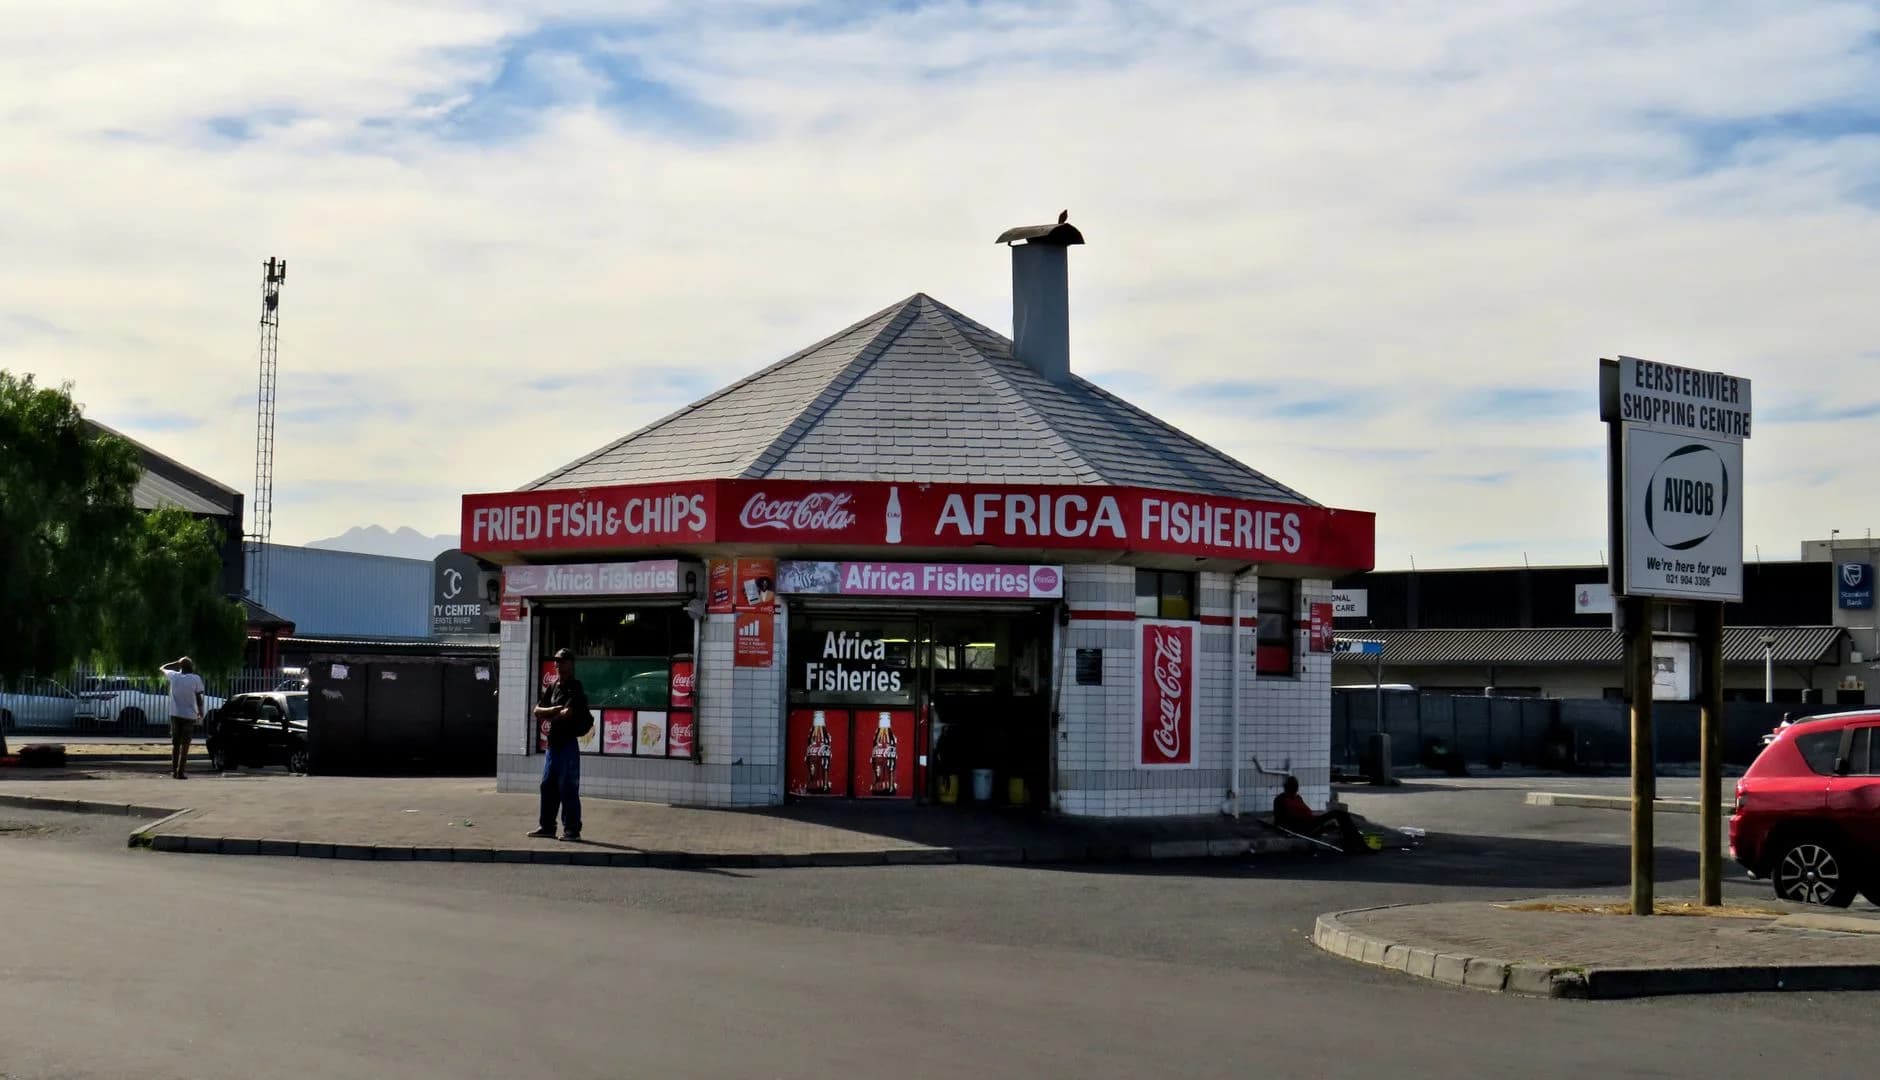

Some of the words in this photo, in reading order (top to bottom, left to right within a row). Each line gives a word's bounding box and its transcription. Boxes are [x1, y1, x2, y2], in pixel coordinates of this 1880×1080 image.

[1635, 361, 1739, 403] EERSTERIVIER
[1623, 393, 1695, 428] SHOPPING
[1700, 407, 1750, 436] CENTRE
[1663, 477, 1714, 516] AVBOB
[473, 505, 541, 542] FRIED
[546, 500, 603, 537] FISH
[605, 507, 621, 535] &
[624, 494, 707, 532] CHIPS
[934, 493, 1127, 538] AFRICA
[1141, 498, 1301, 553] FISHERIES
[544, 567, 594, 591] Africa
[599, 566, 675, 590] Fisheries
[845, 565, 915, 591] Africa
[923, 566, 1029, 593] Fisheries
[1646, 557, 1673, 571] We're
[1674, 560, 1696, 573] here
[1697, 562, 1710, 575] for
[1711, 565, 1728, 577] you
[1665, 574, 1678, 584] 021
[1680, 575, 1693, 585] 904
[445, 604, 481, 617] CENTRE
[1335, 604, 1356, 612] CARE
[822, 631, 886, 661] Africa
[806, 662, 902, 692] Fisheries
[1153, 628, 1182, 759] Coca-Cola
